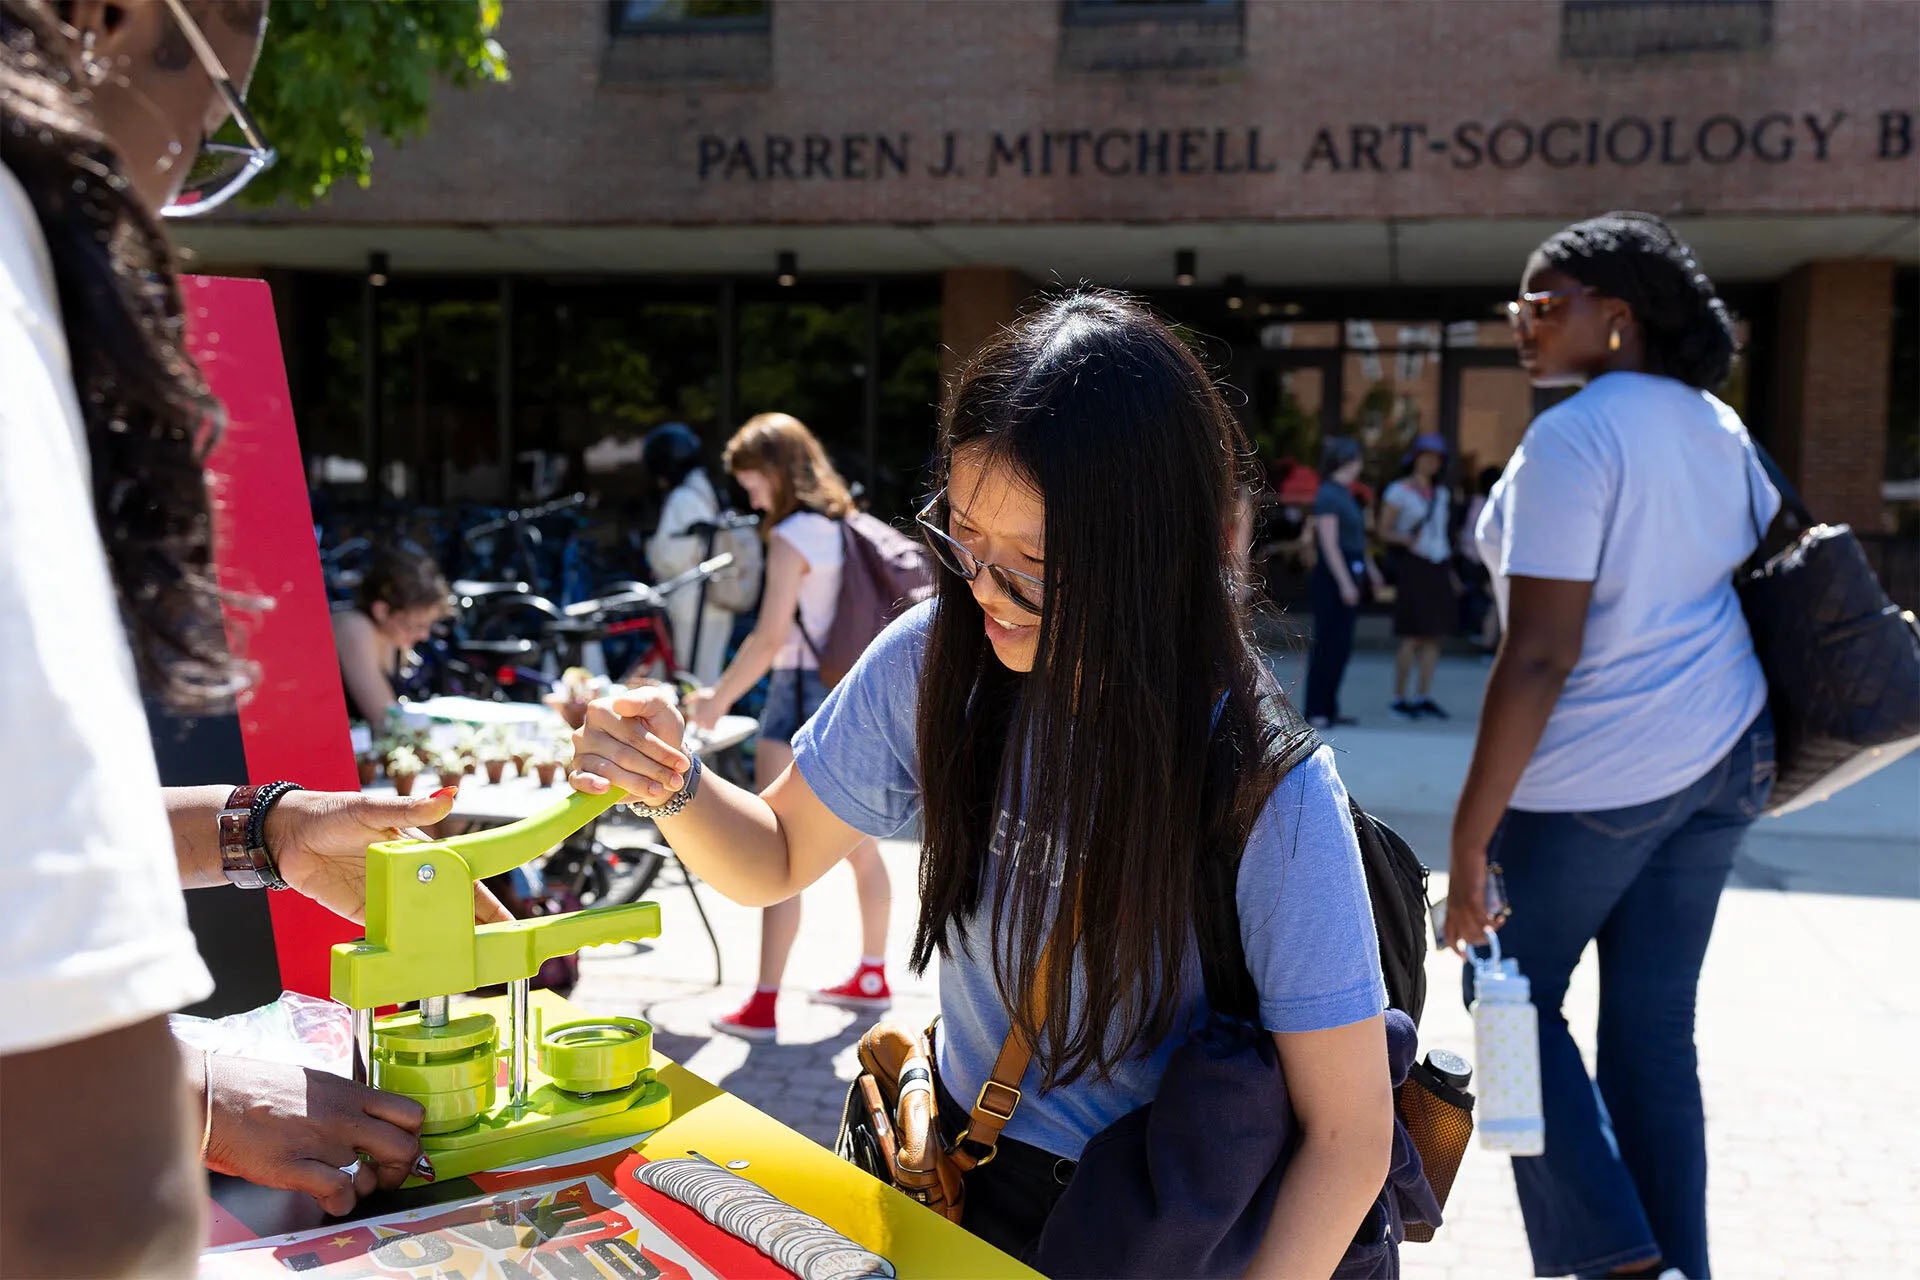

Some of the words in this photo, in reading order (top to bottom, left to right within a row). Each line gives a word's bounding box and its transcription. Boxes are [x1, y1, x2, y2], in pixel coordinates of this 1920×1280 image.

[698, 133, 910, 181] PARREN
[928, 131, 963, 178] J.
[988, 127, 1276, 177] MITCHELL
[1304, 113, 1845, 171] ART-SOCIOLOGY
